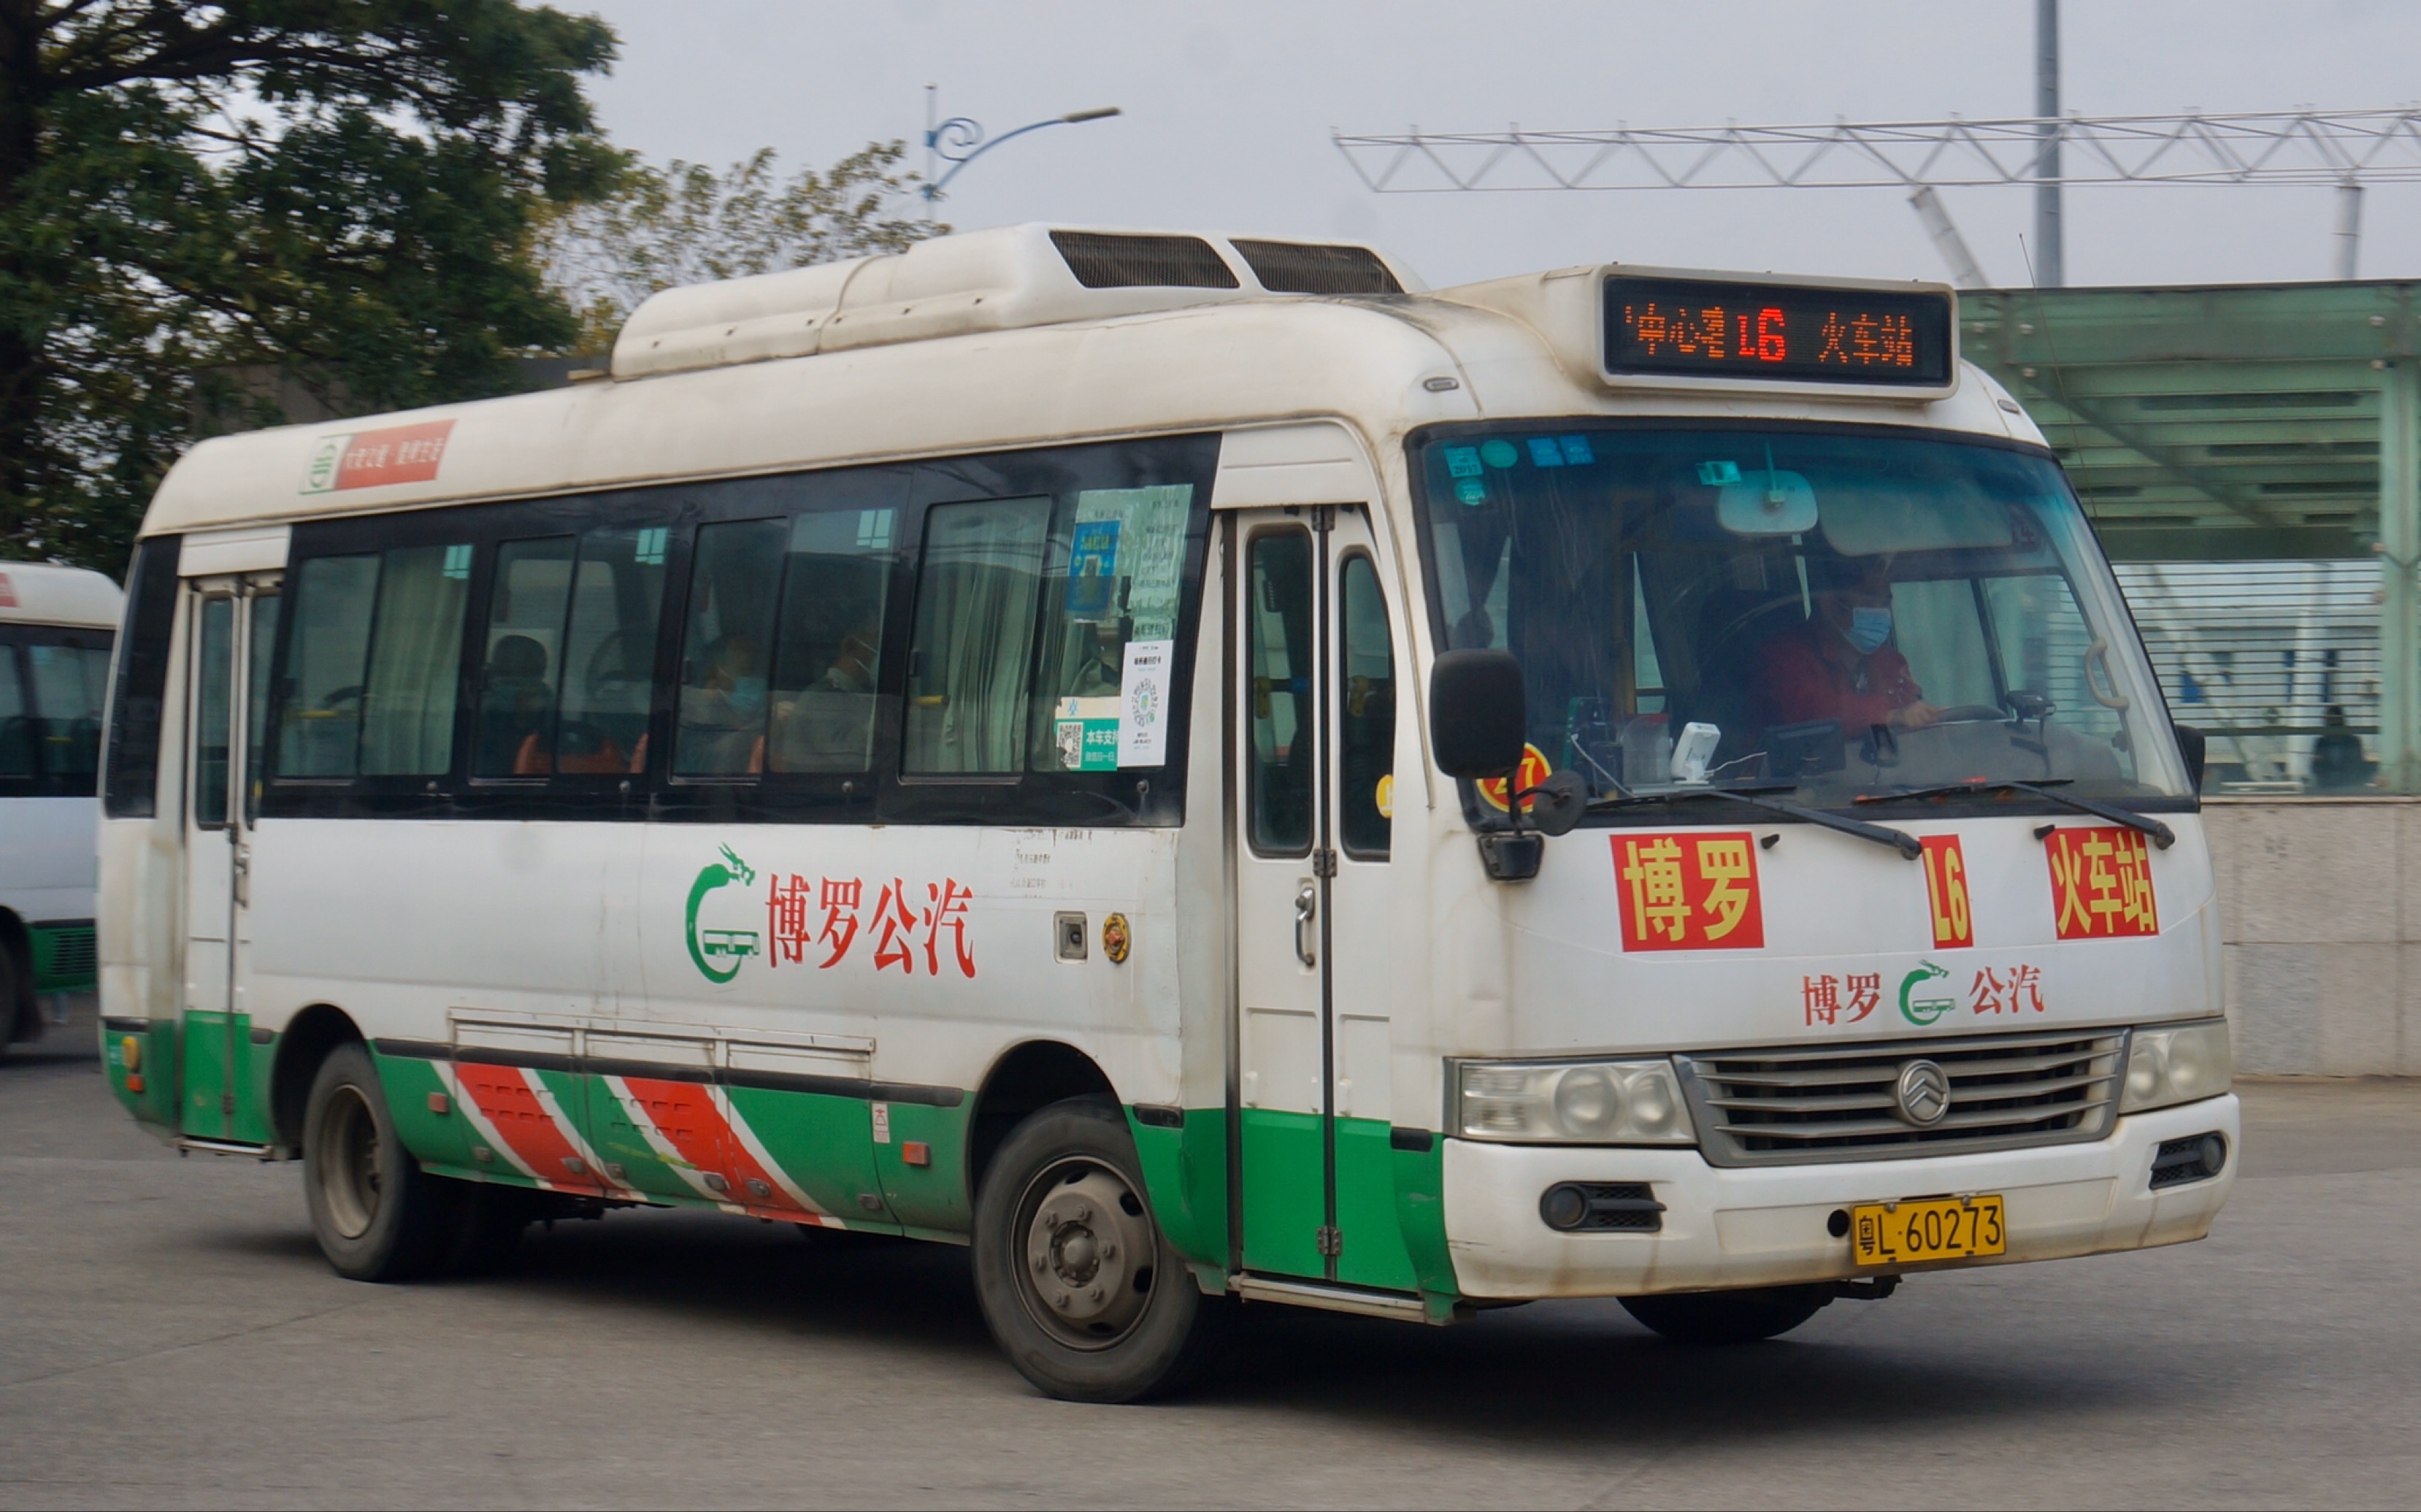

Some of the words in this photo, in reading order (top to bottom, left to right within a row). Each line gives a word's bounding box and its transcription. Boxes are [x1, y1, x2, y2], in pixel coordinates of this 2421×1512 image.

[1736, 307, 1787, 361] L6
[1818, 312, 1913, 367] 火车站
[765, 874, 976, 978] 博罗公汽
[1623, 837, 1750, 941] 博罗
[1924, 847, 1969, 942] L6
[2052, 830, 2157, 934] 火车站
[1800, 973, 1880, 1026] 博罗
[1968, 964, 2044, 1013] 公汽
